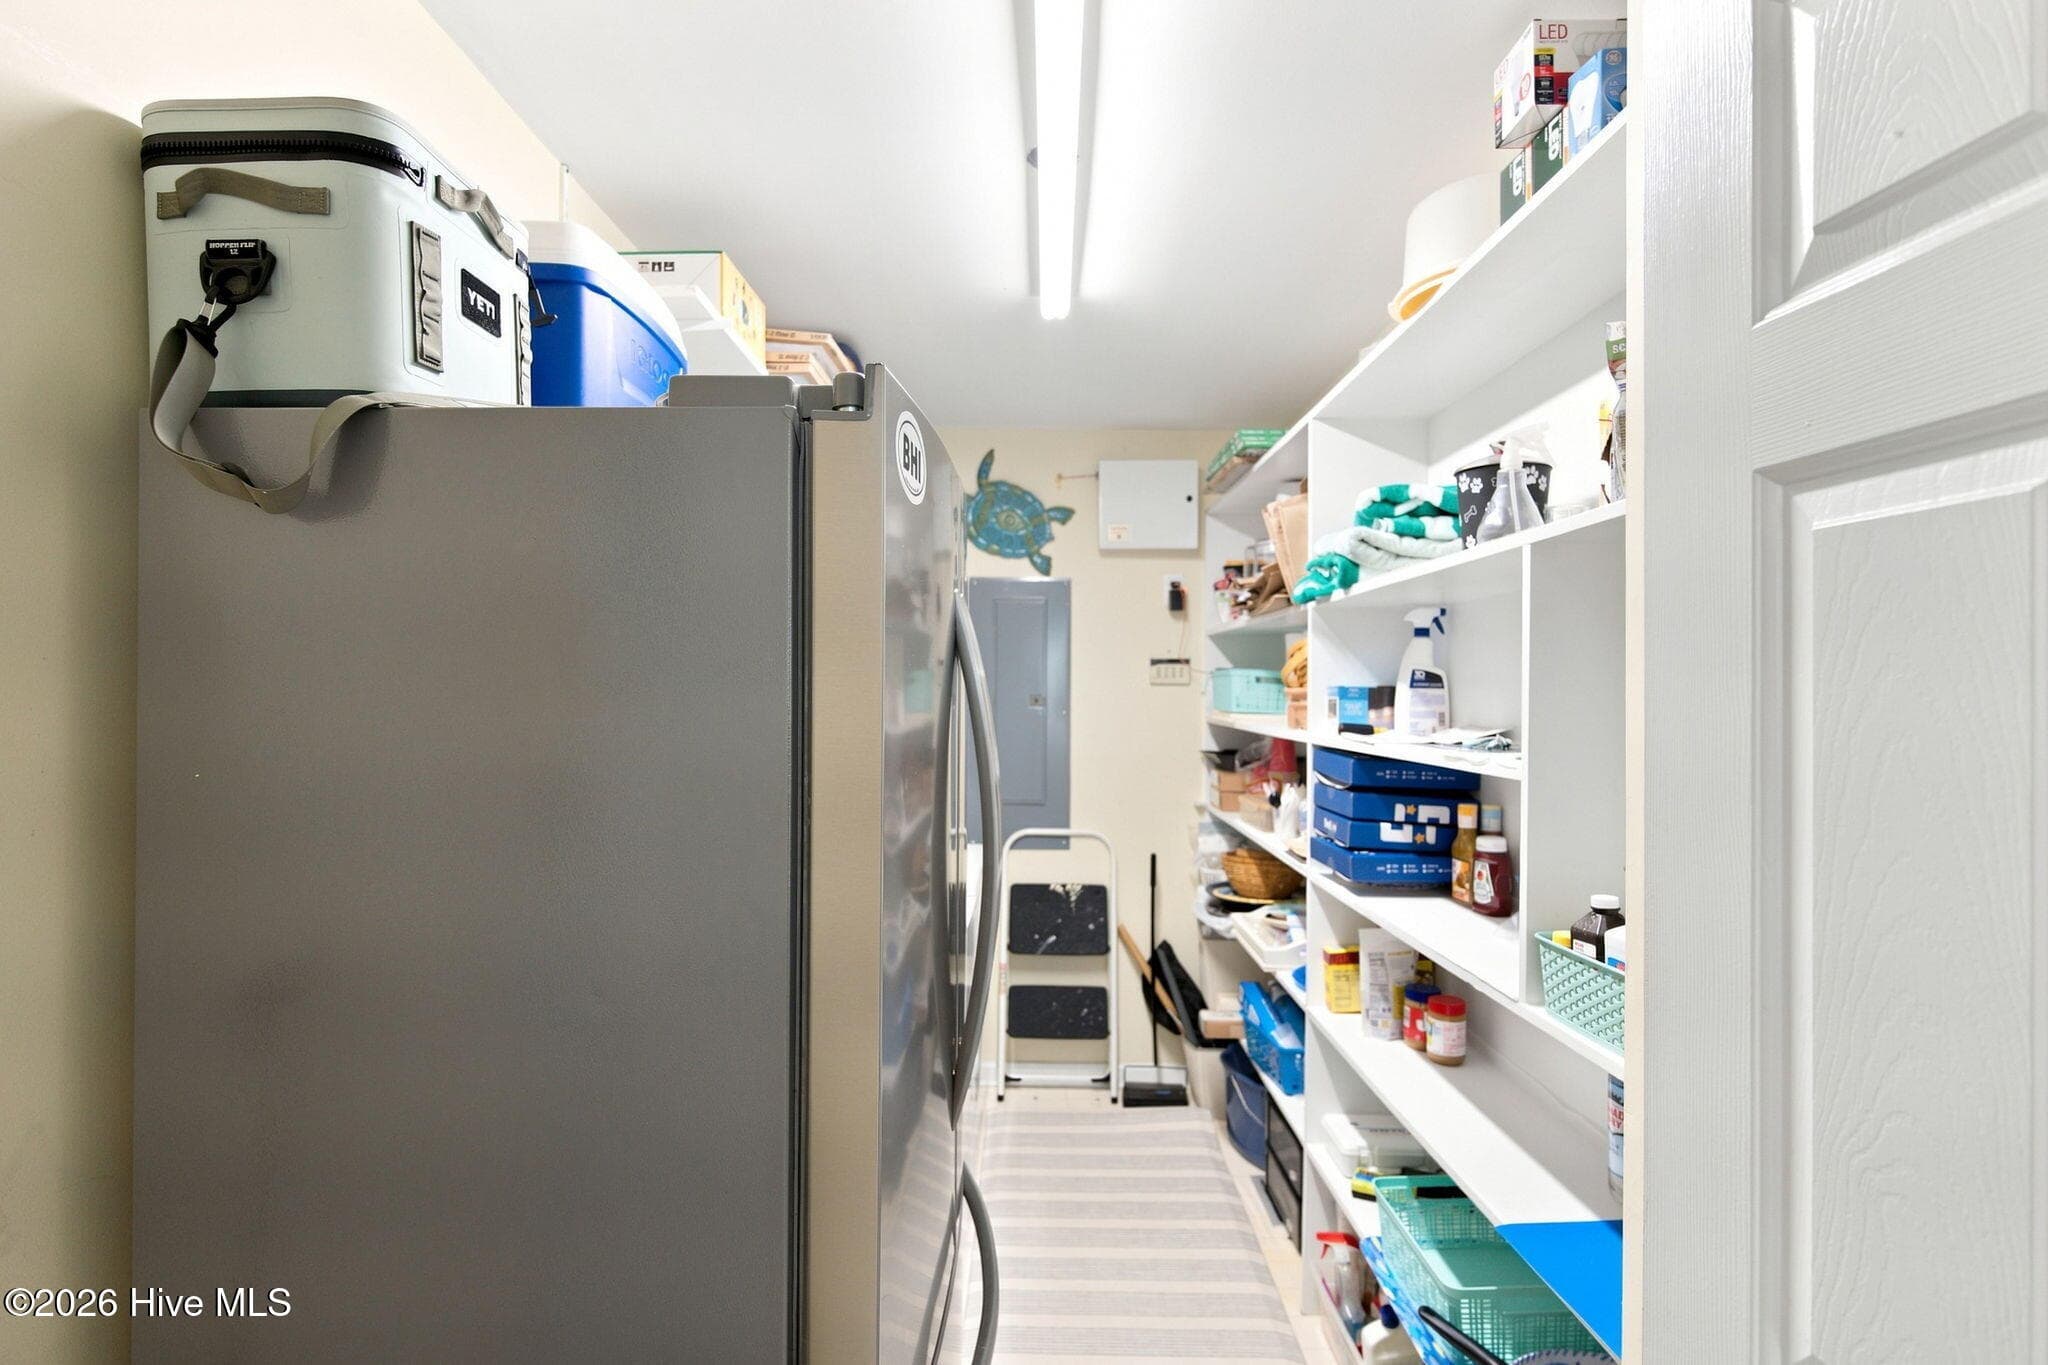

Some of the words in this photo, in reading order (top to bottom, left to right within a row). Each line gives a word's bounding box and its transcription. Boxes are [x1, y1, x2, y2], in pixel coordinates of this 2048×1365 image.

[1539, 24, 1568, 40] LED
[467, 287, 496, 320] YETI
[903, 432, 921, 484] BHI
